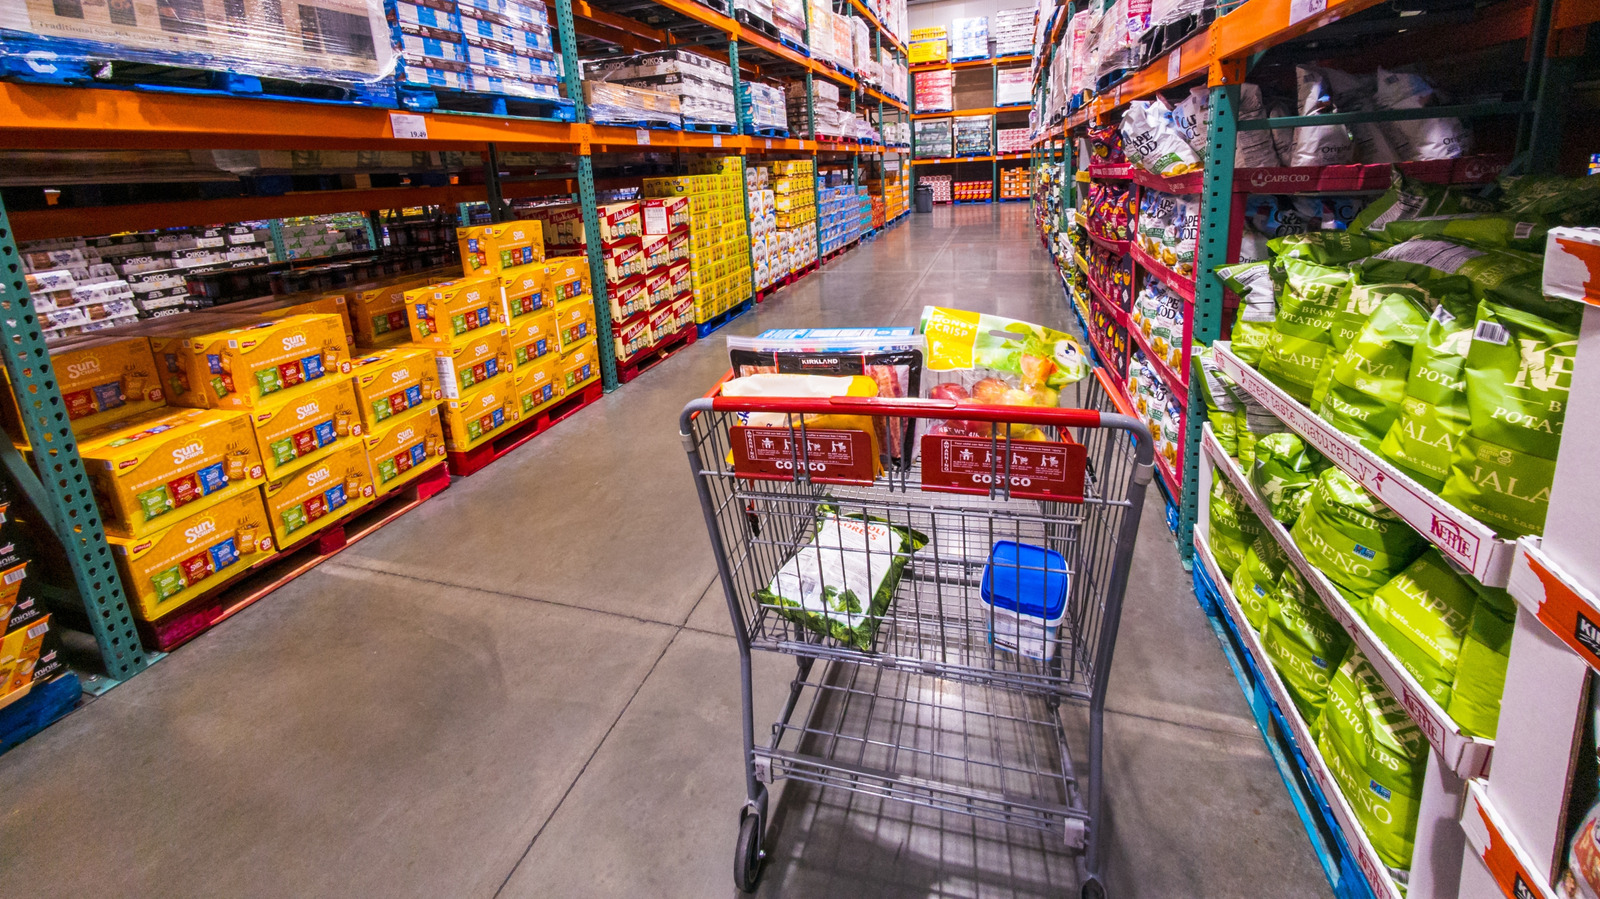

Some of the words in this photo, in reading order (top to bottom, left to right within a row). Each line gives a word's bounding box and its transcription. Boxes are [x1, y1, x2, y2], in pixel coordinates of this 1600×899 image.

[39, 22, 93, 34] Traditional
[642, 56, 664, 66] OIKOS
[1264, 174, 1288, 183] CAPE
[1289, 174, 1310, 182] COD
[126, 256, 152, 265] OIKOS
[186, 250, 210, 258] OIKOS
[142, 274, 169, 282] OIKOS
[154, 308, 180, 318] OIKOS
[934, 314, 978, 330] HONEY
[935, 323, 968, 338] CRISP
[282, 334, 306, 351] Sun
[67, 360, 101, 379] Sun
[391, 368, 410, 384] Sun
[1247, 382, 1271, 402] great
[296, 403, 318, 420] Sun
[1492, 406, 1564, 436] POTA
[397, 428, 414, 444] Sun
[172, 442, 204, 465] Sun
[747, 434, 755, 460] WARNING
[776, 460, 826, 472] COSTCO
[1420, 461, 1448, 475] taste
[307, 468, 330, 487] Sun
[1338, 506, 1389, 534] CHIPS
[184, 520, 216, 544] Sun
[832, 520, 877, 541] LORES
[1430, 512, 1472, 561] KETTLE
[11, 610, 37, 626] minis
[34, 662, 59, 678] minis
[1403, 684, 1440, 746] KETTLE
